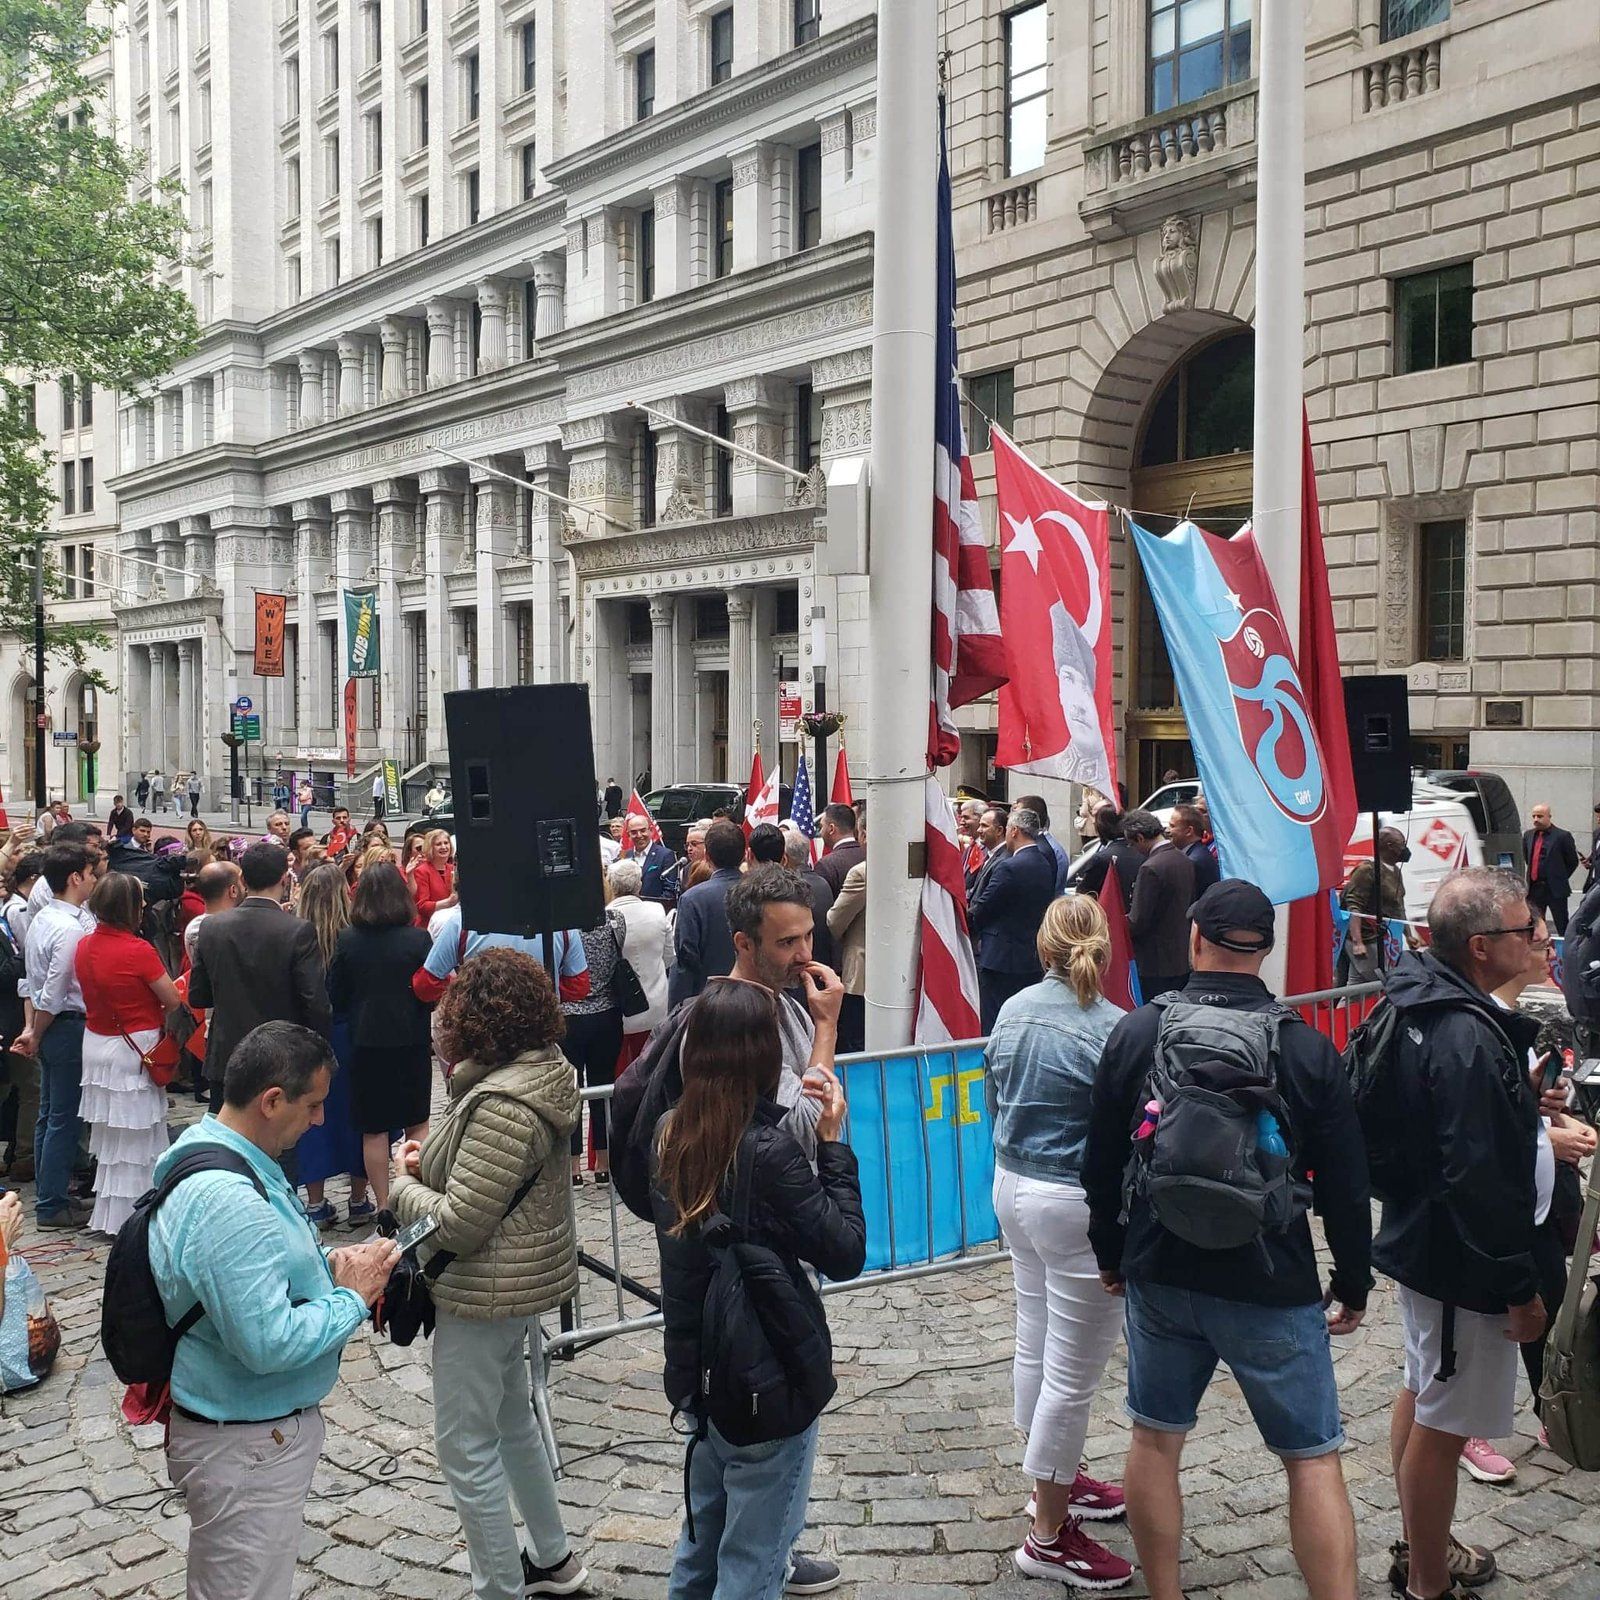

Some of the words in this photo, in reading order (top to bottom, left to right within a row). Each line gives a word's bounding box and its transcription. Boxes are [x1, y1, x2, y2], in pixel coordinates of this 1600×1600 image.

[431, 424, 475, 447] OFFICES
[264, 608, 275, 659] WINE
[352, 598, 372, 669] SUBWAY
[1413, 674, 1430, 686] 25
[385, 761, 399, 807] SUBWAY
